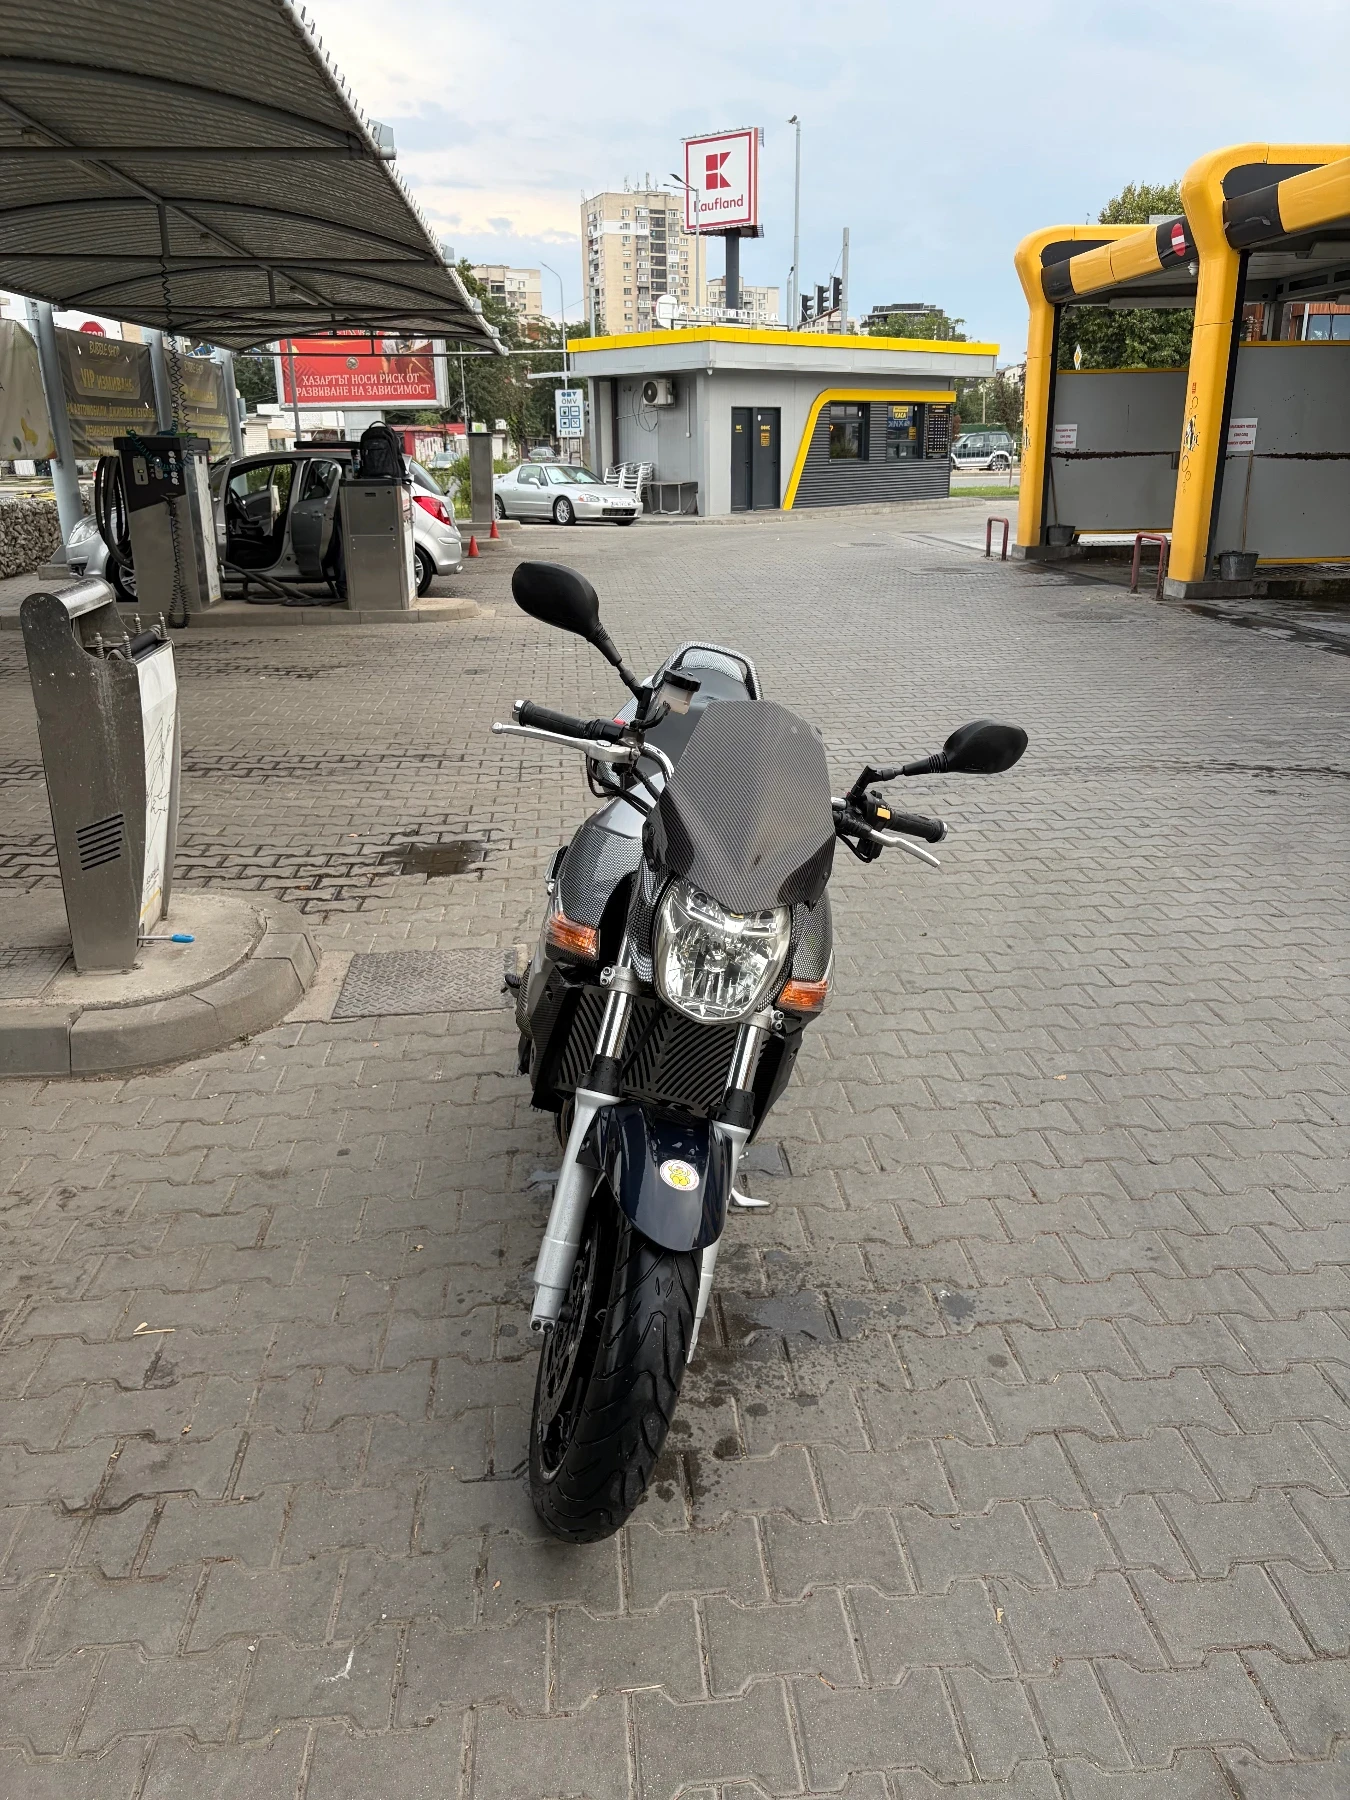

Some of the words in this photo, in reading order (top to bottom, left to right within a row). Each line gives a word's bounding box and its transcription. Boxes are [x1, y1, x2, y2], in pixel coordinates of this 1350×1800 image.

[81, 368, 95, 389] VIP
[302, 374, 349, 386] ХАЗАРТЪТ
[352, 374, 378, 385] НОСИ
[379, 374, 404, 384] РИСК
[406, 373, 420, 383] ОТ
[296, 386, 349, 397] РАЗВИВАНЕ
[352, 386, 365, 396] НА
[366, 384, 431, 396] ЗАВИСИМОСТ
